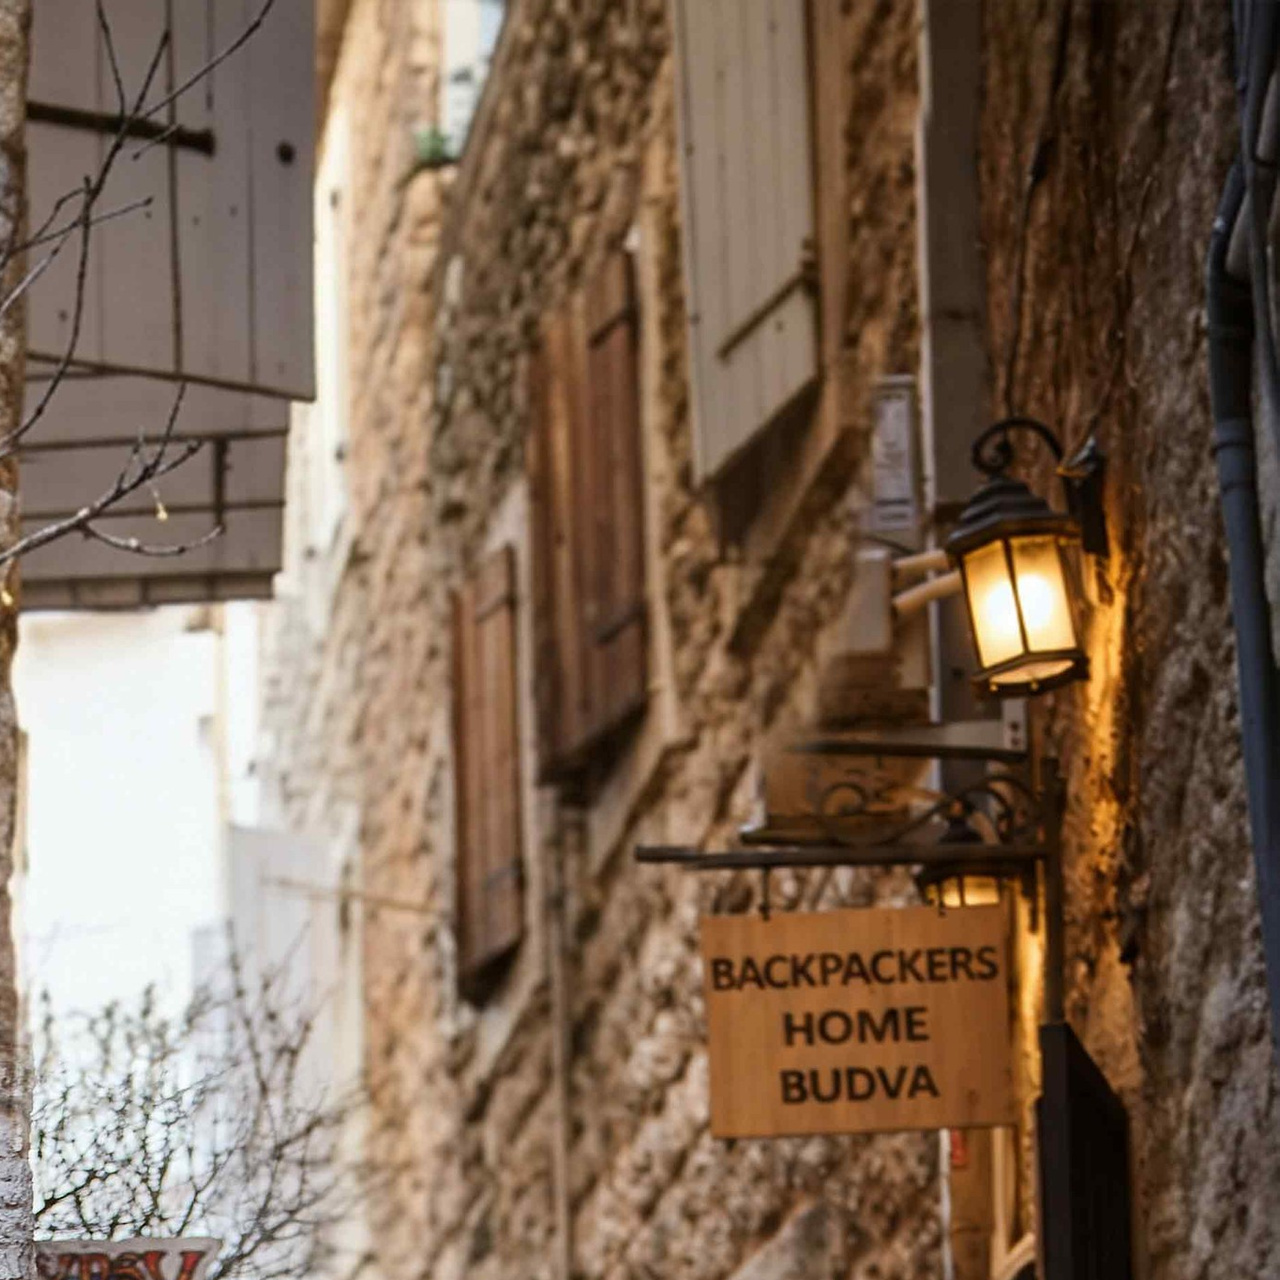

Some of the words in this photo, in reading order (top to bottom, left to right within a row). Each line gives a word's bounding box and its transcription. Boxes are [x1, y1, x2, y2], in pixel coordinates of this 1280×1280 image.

[710, 946, 1000, 992] BACKPACKERS
[782, 1006, 931, 1048] HOME
[780, 1065, 941, 1106] BUDVA
